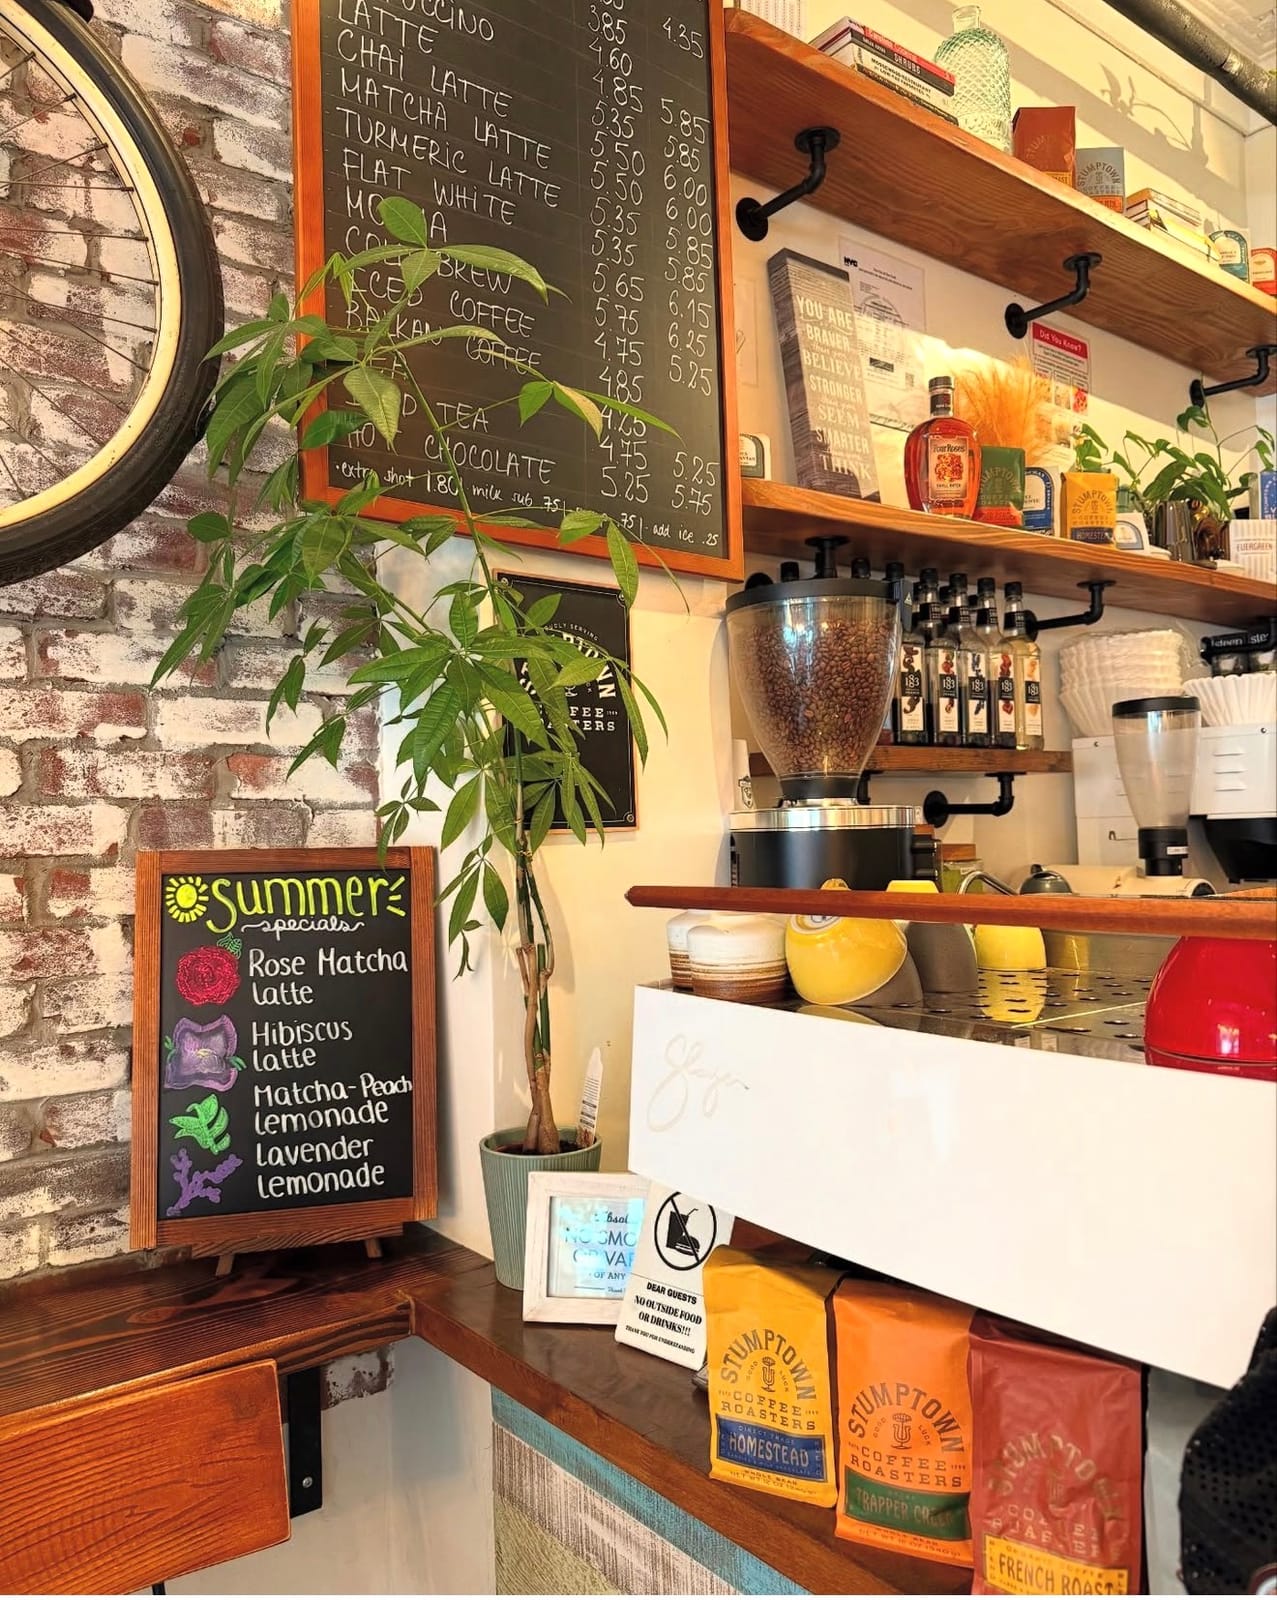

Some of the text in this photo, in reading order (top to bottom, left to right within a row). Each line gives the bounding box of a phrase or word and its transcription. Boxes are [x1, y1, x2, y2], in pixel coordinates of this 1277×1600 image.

[338, 0, 632, 76] LATTE 4.60
[588, 5, 627, 44] 3.85
[663, 17, 704, 58] 4.35
[430, 65, 513, 117] LATTE
[592, 101, 634, 139] 5.35
[663, 134, 700, 173] 5.85
[592, 69, 710, 145] 4.85 5.85
[341, 67, 707, 206] MATCHA LATTE 5.50 6.00
[1077, 161, 1121, 187] STUMPTOWN
[343, 149, 411, 192] FLAT
[590, 199, 641, 236] 5.35
[665, 227, 712, 269] 5.85
[488, 160, 561, 208] LATTE
[591, 161, 643, 206] 5.50
[664, 198, 712, 236] 6.00
[347, 185, 707, 293] MOA 5.35 5.85
[593, 263, 645, 302] 5.65
[669, 290, 712, 329] 6.15
[796, 295, 823, 320] YOU
[828, 307, 854, 330] ARE
[449, 290, 536, 338] COFFEE
[595, 298, 640, 335] 5.75
[668, 322, 707, 358] 6.25
[806, 323, 850, 353] BRAVER
[346, 300, 712, 396] BAKAN COFFEE 4.75 5.25
[803, 349, 861, 380] BELIEVE
[599, 369, 642, 404] 4.85
[809, 374, 863, 405] STRONGER
[436, 401, 489, 434] TEA
[818, 404, 860, 429] SEEM
[815, 427, 870, 454] SMARTER
[424, 434, 556, 485] CHOCOLATE
[600, 435, 647, 471] 4.75
[673, 451, 719, 487] 5.25
[819, 454, 872, 480] THINK
[341, 461, 373, 480] extr
[384, 466, 414, 488] shot
[472, 484, 502, 501] milk
[512, 492, 533, 508] sub
[653, 523, 672, 539] add
[678, 525, 695, 544] ice
[702, 533, 720, 546] .25
[601, 466, 713, 516] 5.25 5.75
[570, 623, 599, 642] SERVING
[241, 916, 365, 941] specials
[249, 947, 408, 977] Rose Matcha
[252, 1019, 353, 1047] Hibiscus
[608, 1272, 626, 1280] ANY
[634, 1295, 702, 1325] NO OUTSIDE FOOD
[646, 1282, 697, 1305] DEAR GUESTS
[638, 1311, 650, 1323] OR
[625, 1325, 640, 1335] THANK
[649, 1333, 658, 1341] FOR
[658, 1335, 695, 1354] UNDERSTANDING
[720, 1328, 817, 1400] STUMPTOWN
[721, 1400, 817, 1431] ROASTERS
[733, 1390, 803, 1417] COFFEE
[848, 1382, 964, 1454] STUMPTOWN
[729, 1432, 810, 1468] HOMESTEAD
[861, 1446, 947, 1471] COFFEE
[850, 1454, 962, 1488] ROASTERS
[857, 1488, 909, 1520] TRAPPER
[998, 1552, 1055, 1593] FRENCH
